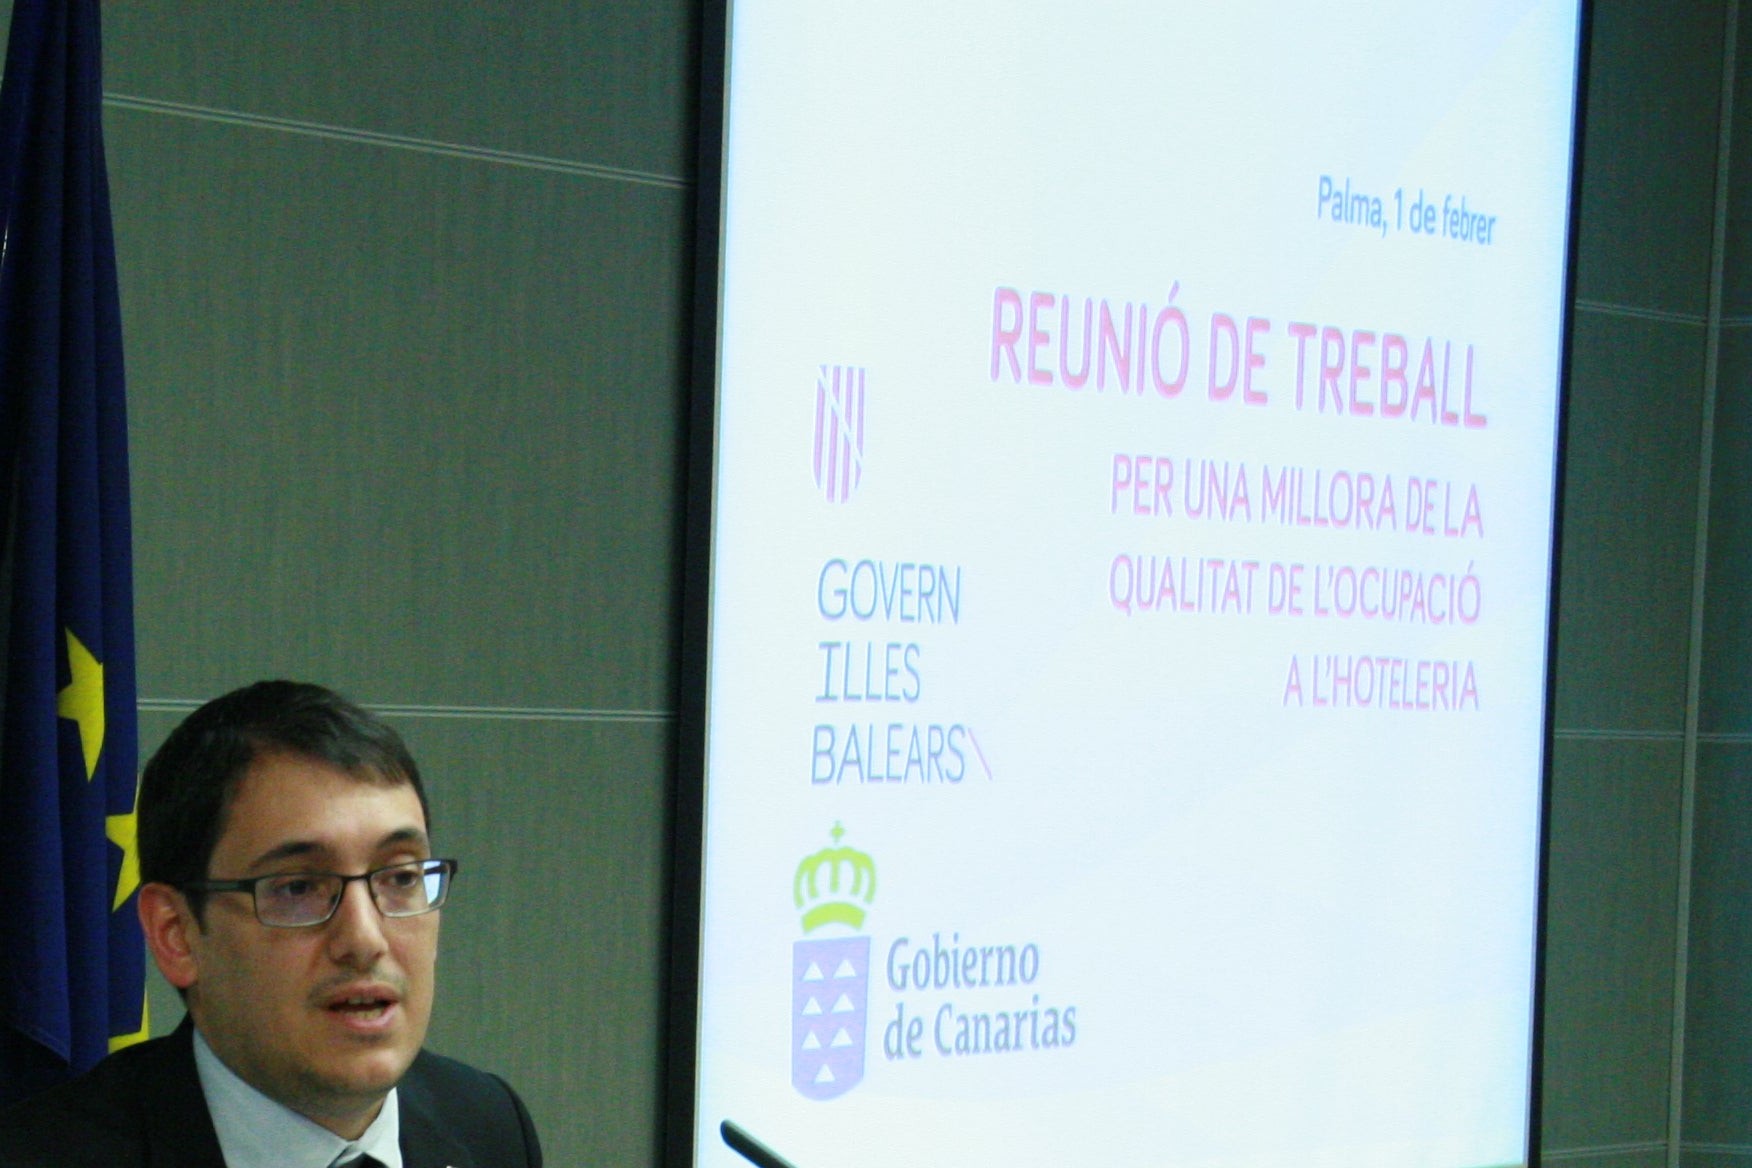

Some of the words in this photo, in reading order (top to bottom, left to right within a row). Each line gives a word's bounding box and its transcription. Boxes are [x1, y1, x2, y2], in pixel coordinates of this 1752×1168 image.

[1318, 174, 1388, 238] Palma,
[1393, 187, 1403, 231] 1
[1409, 188, 1437, 235] de
[1442, 194, 1497, 245] febrer
[990, 279, 1190, 400] REUNIÓ
[1208, 312, 1271, 406] DE
[1287, 320, 1488, 430] TREBALL
[1111, 453, 1174, 519] PER
[1183, 457, 1252, 524] UNA
[1260, 464, 1397, 532] MILLORA
[1405, 475, 1438, 536] DE
[1443, 480, 1484, 539] LA
[817, 557, 962, 626] GOVERN
[1109, 553, 1261, 617] QUALITAT
[1267, 561, 1305, 617] DE
[1313, 559, 1482, 625] L'OCUPACIÓ
[814, 641, 922, 704] ILLES
[1282, 653, 1304, 708] A
[1312, 654, 1480, 712] L'HOTELERIA
[810, 723, 967, 786] BALEARS
[885, 932, 1040, 992] Gobierno
[882, 1001, 924, 1062] de
[933, 994, 1078, 1058] Canarias
